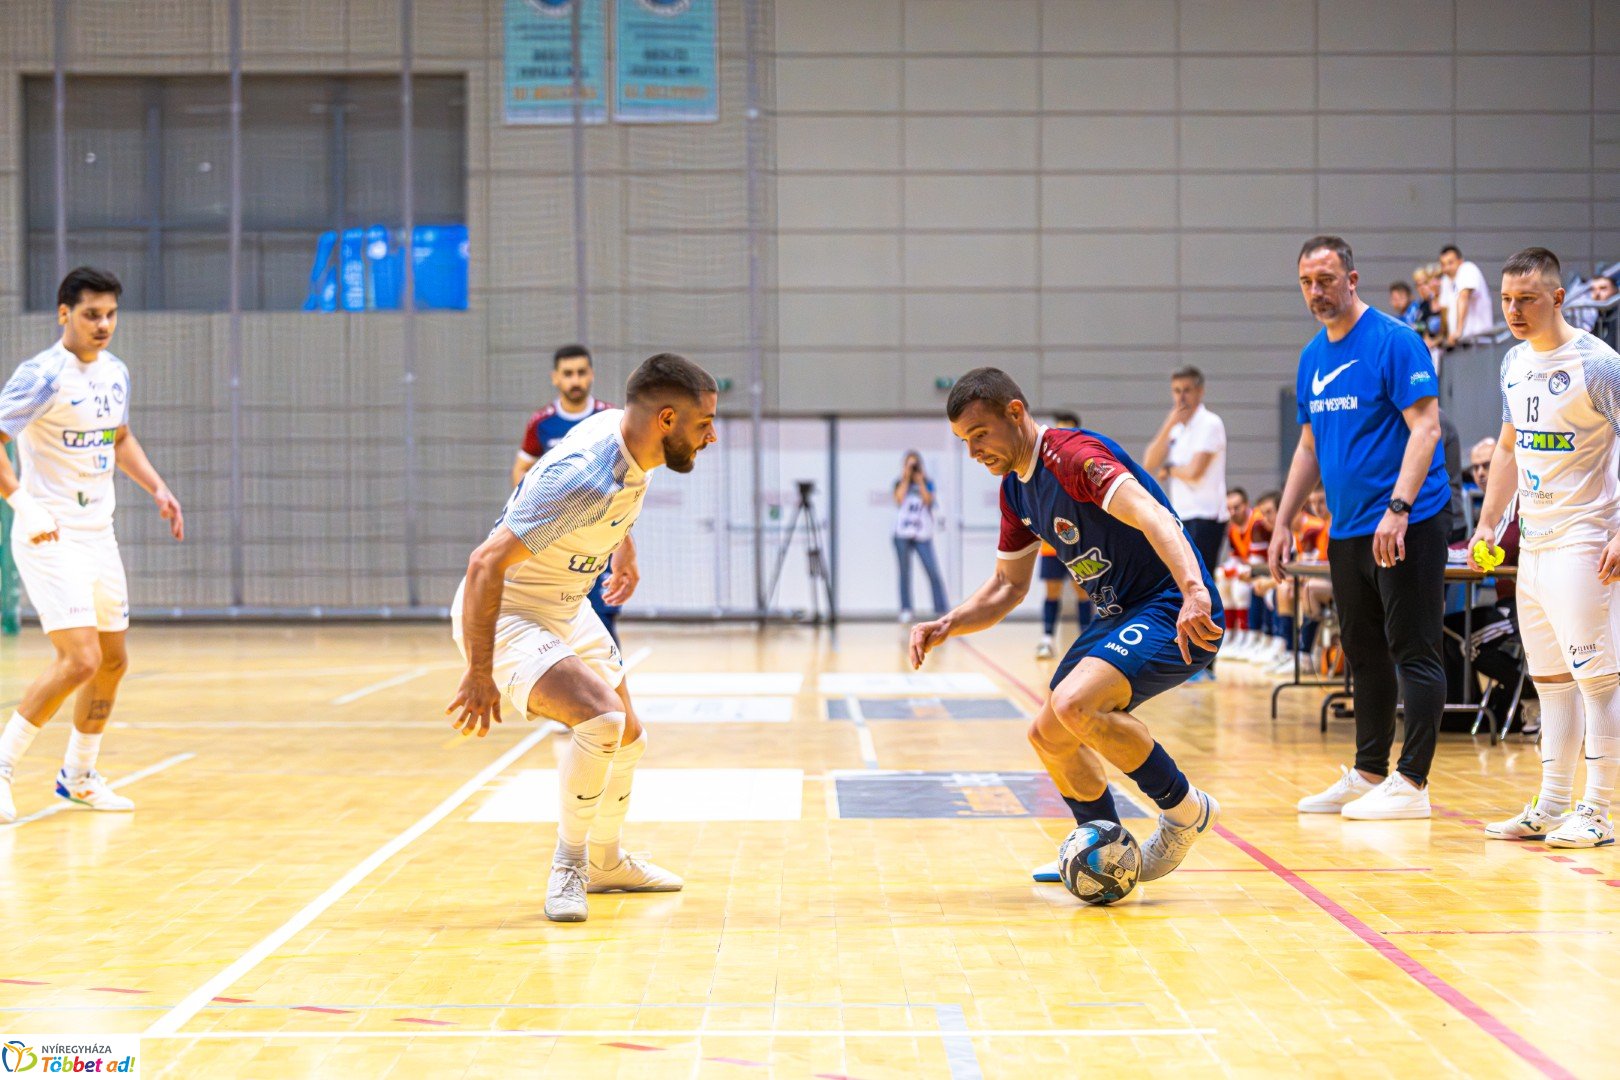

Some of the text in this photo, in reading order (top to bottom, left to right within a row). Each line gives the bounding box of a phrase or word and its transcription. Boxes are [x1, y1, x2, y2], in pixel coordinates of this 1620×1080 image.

[94, 395, 111, 418] 24
[1526, 396, 1540, 423] 13
[1516, 430, 1575, 451] PPMIX
[1119, 624, 1149, 645] 6
[1104, 641, 1129, 656] JAKO
